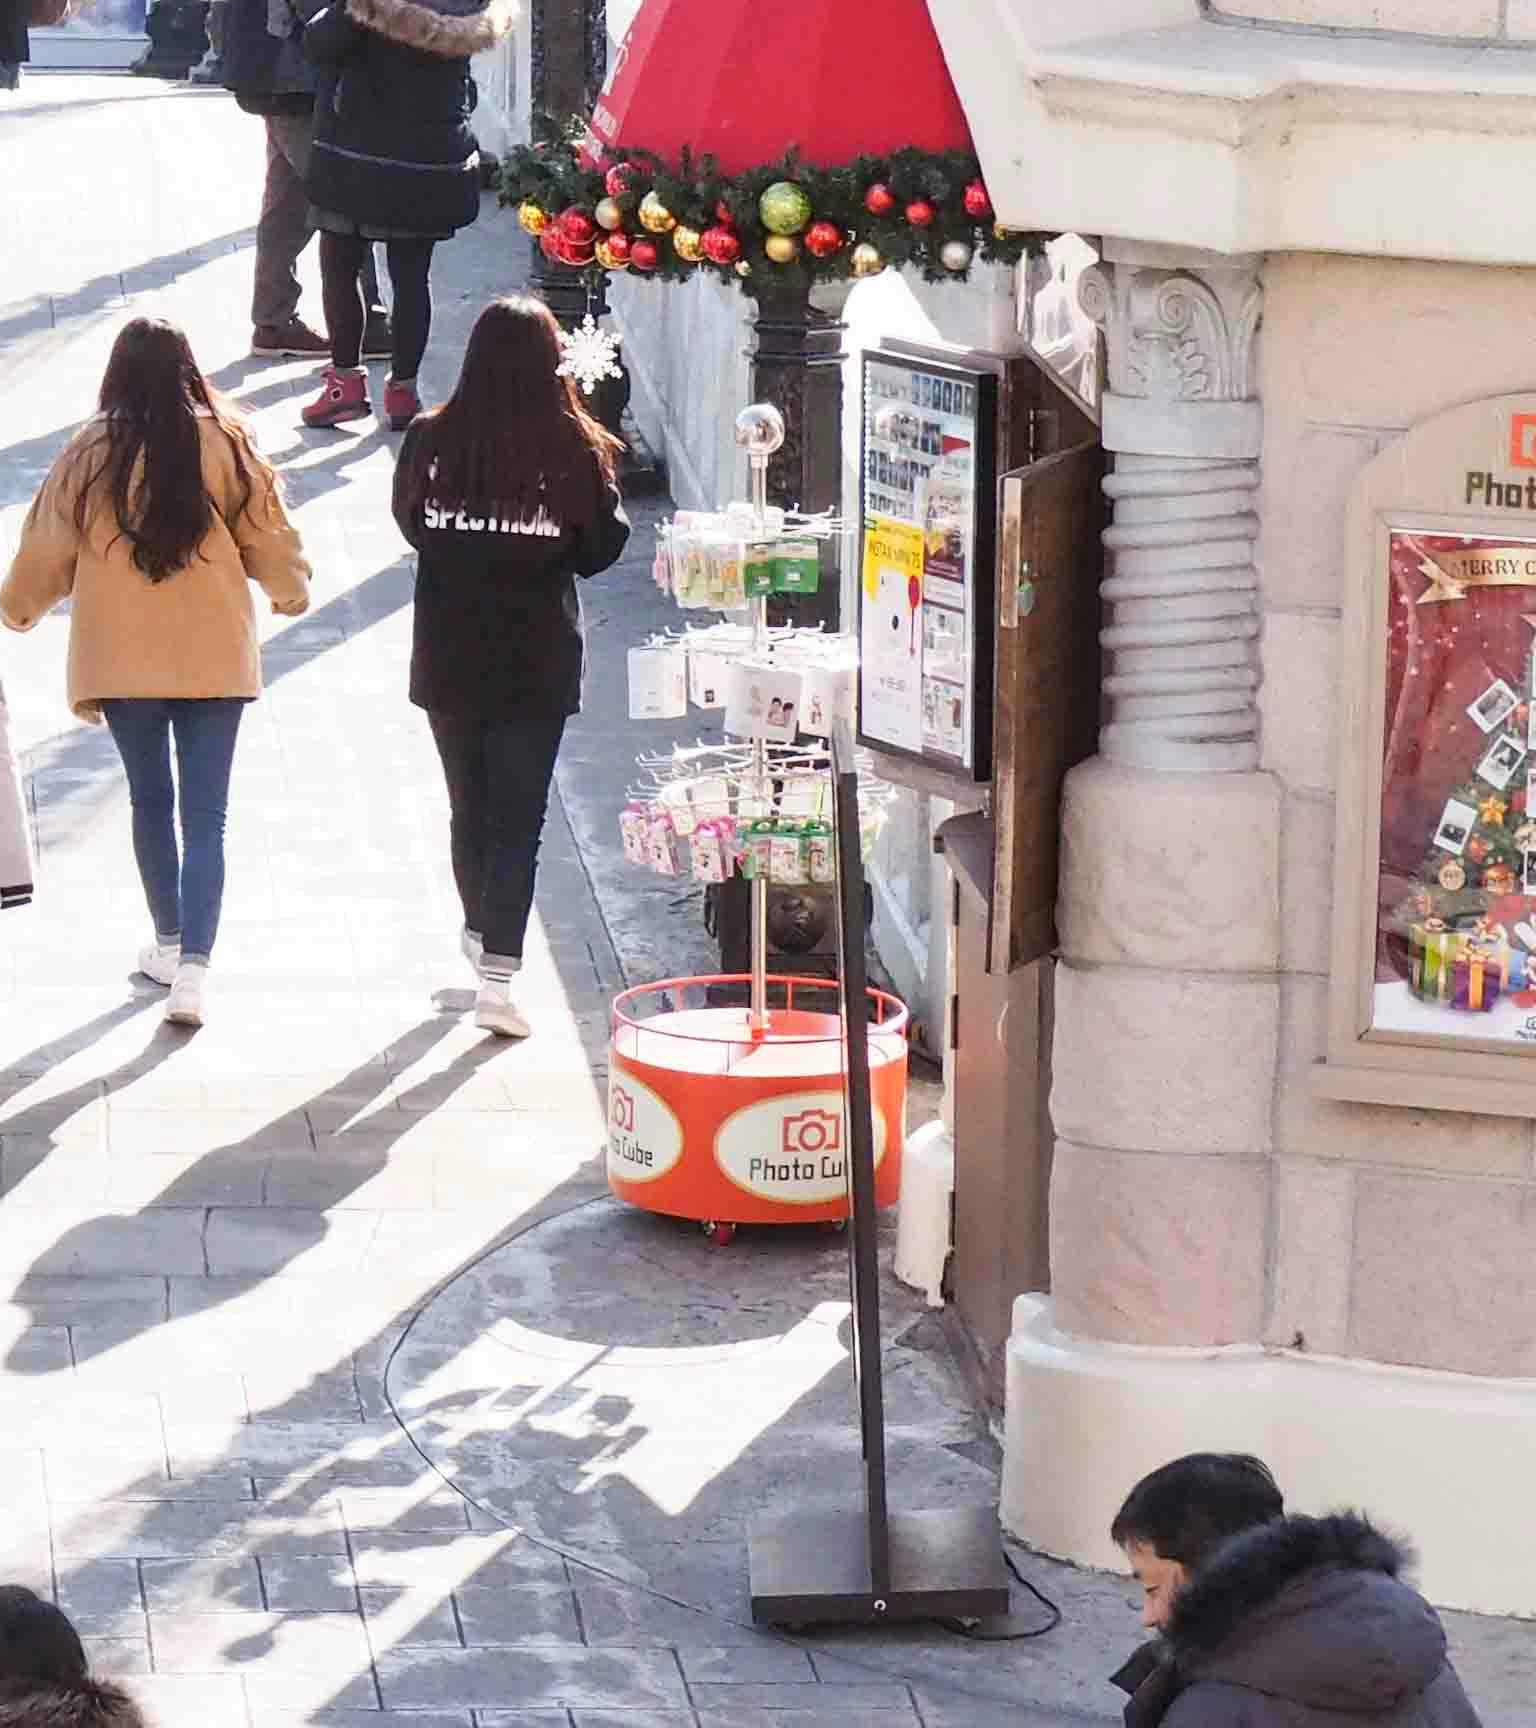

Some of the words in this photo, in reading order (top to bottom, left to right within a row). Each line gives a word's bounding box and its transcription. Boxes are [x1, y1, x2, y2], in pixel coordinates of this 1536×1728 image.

[1465, 471, 1536, 510] Phot
[622, 1136, 654, 1168] Cube
[749, 1157, 815, 1182] Photo
[821, 1155, 845, 1179] Cu
